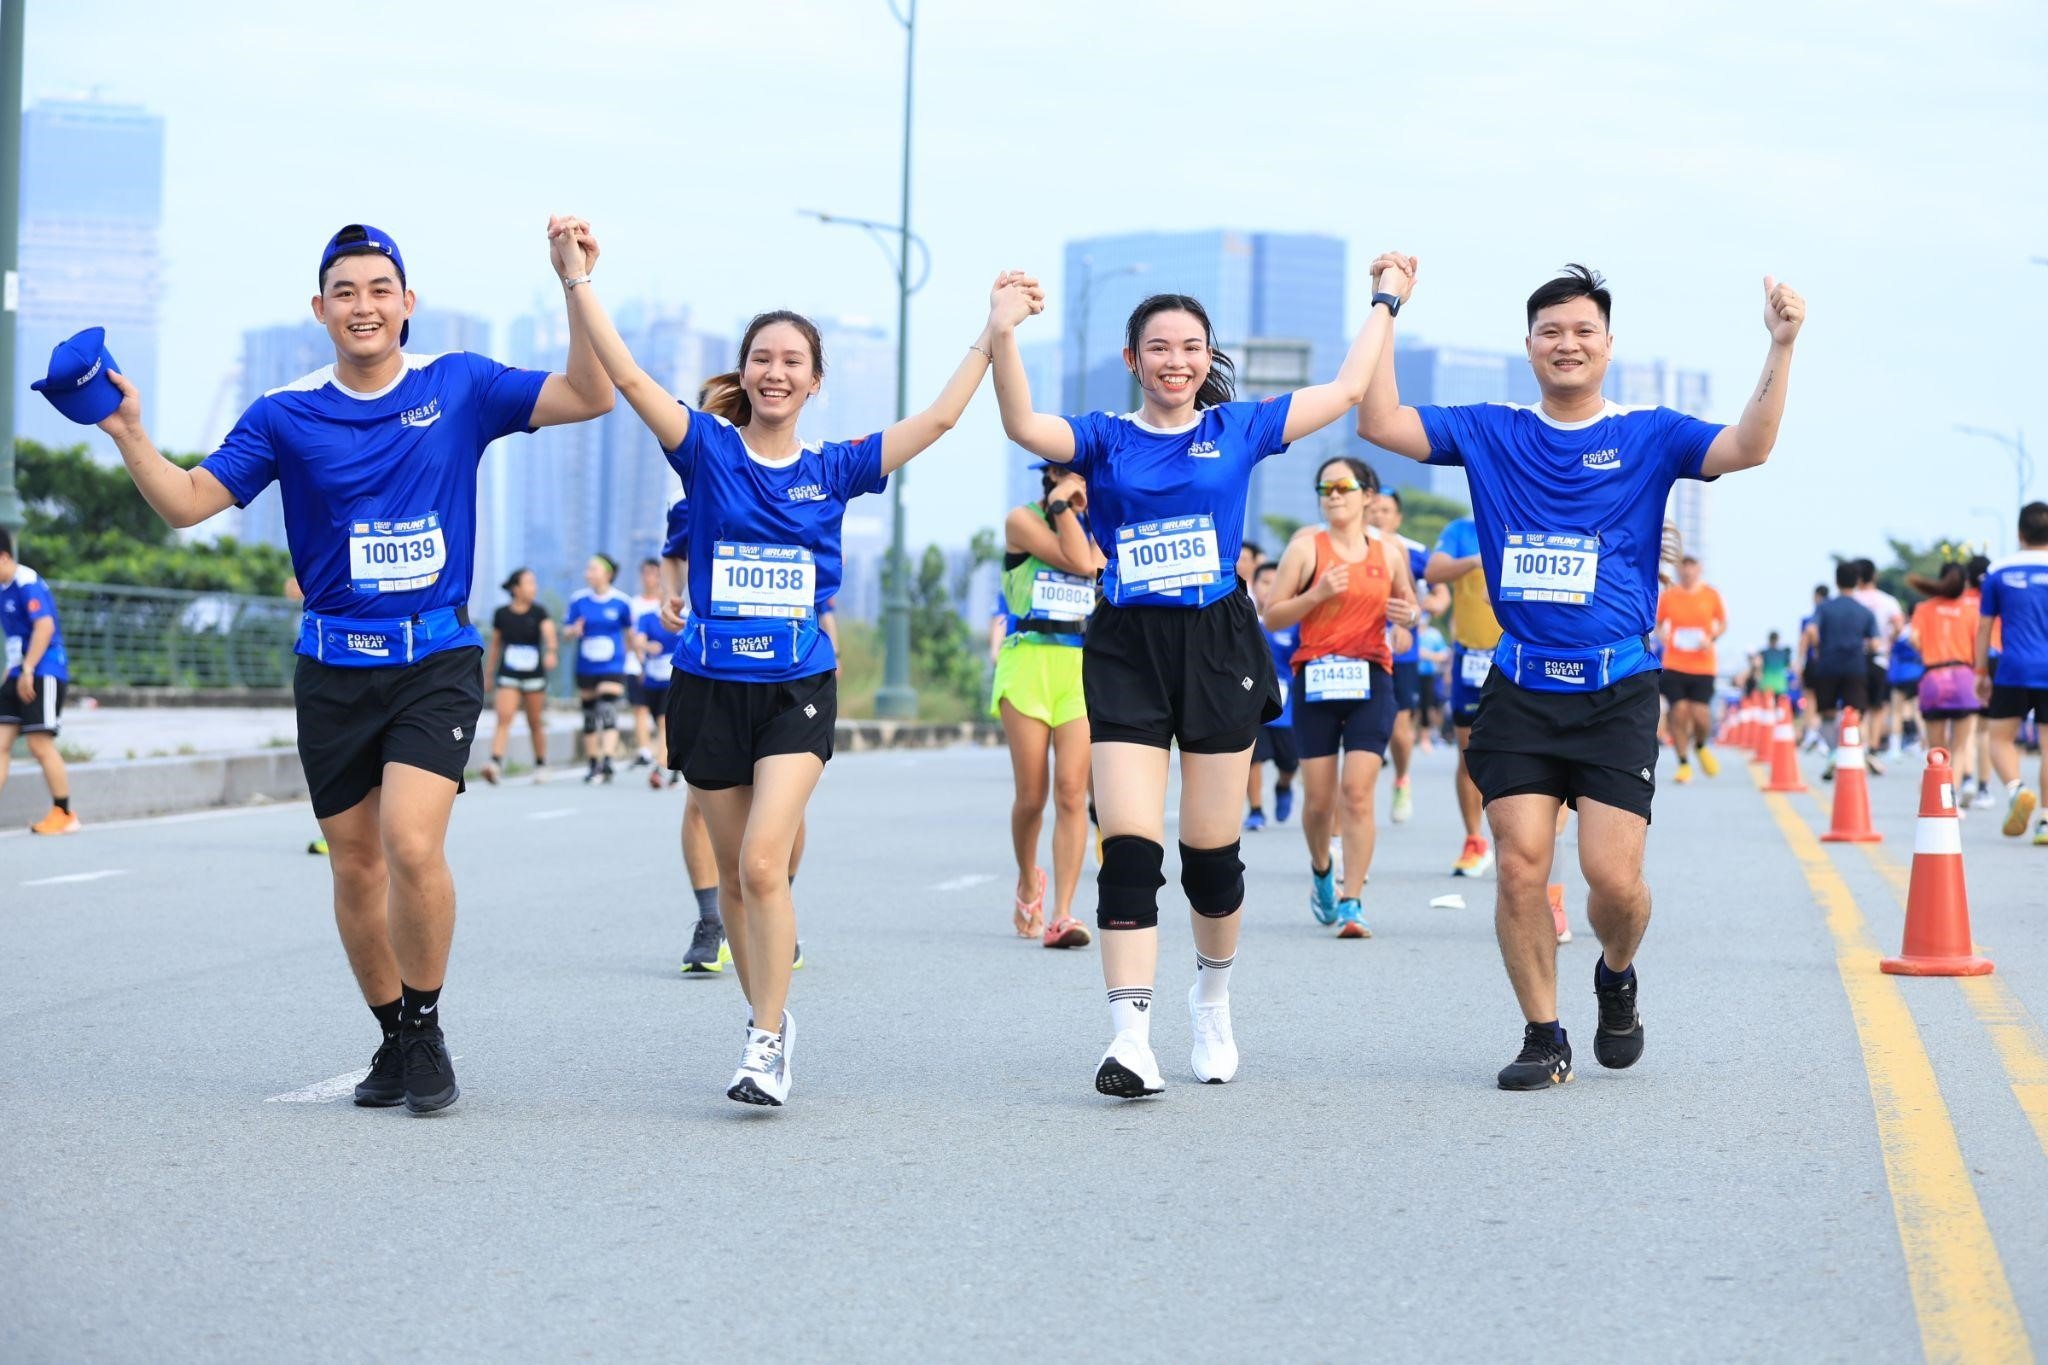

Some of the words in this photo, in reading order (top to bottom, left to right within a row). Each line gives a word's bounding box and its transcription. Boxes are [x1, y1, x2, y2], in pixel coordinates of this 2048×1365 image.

[1582, 448, 1618, 460] POCARI
[787, 484, 822, 495] POCARI
[362, 537, 435, 564] 100139
[1129, 537, 1206, 567] 100136
[1514, 554, 1585, 577] 100137
[725, 566, 804, 590] 100138
[1041, 586, 1090, 605] 100804
[347, 640, 384, 648] SWEAT
[731, 636, 773, 646] POCARI
[732, 643, 769, 651] SWEAT
[1545, 661, 1584, 670] POCARI
[1312, 666, 1363, 682] 214433
[1545, 668, 1580, 676] SWEAT
